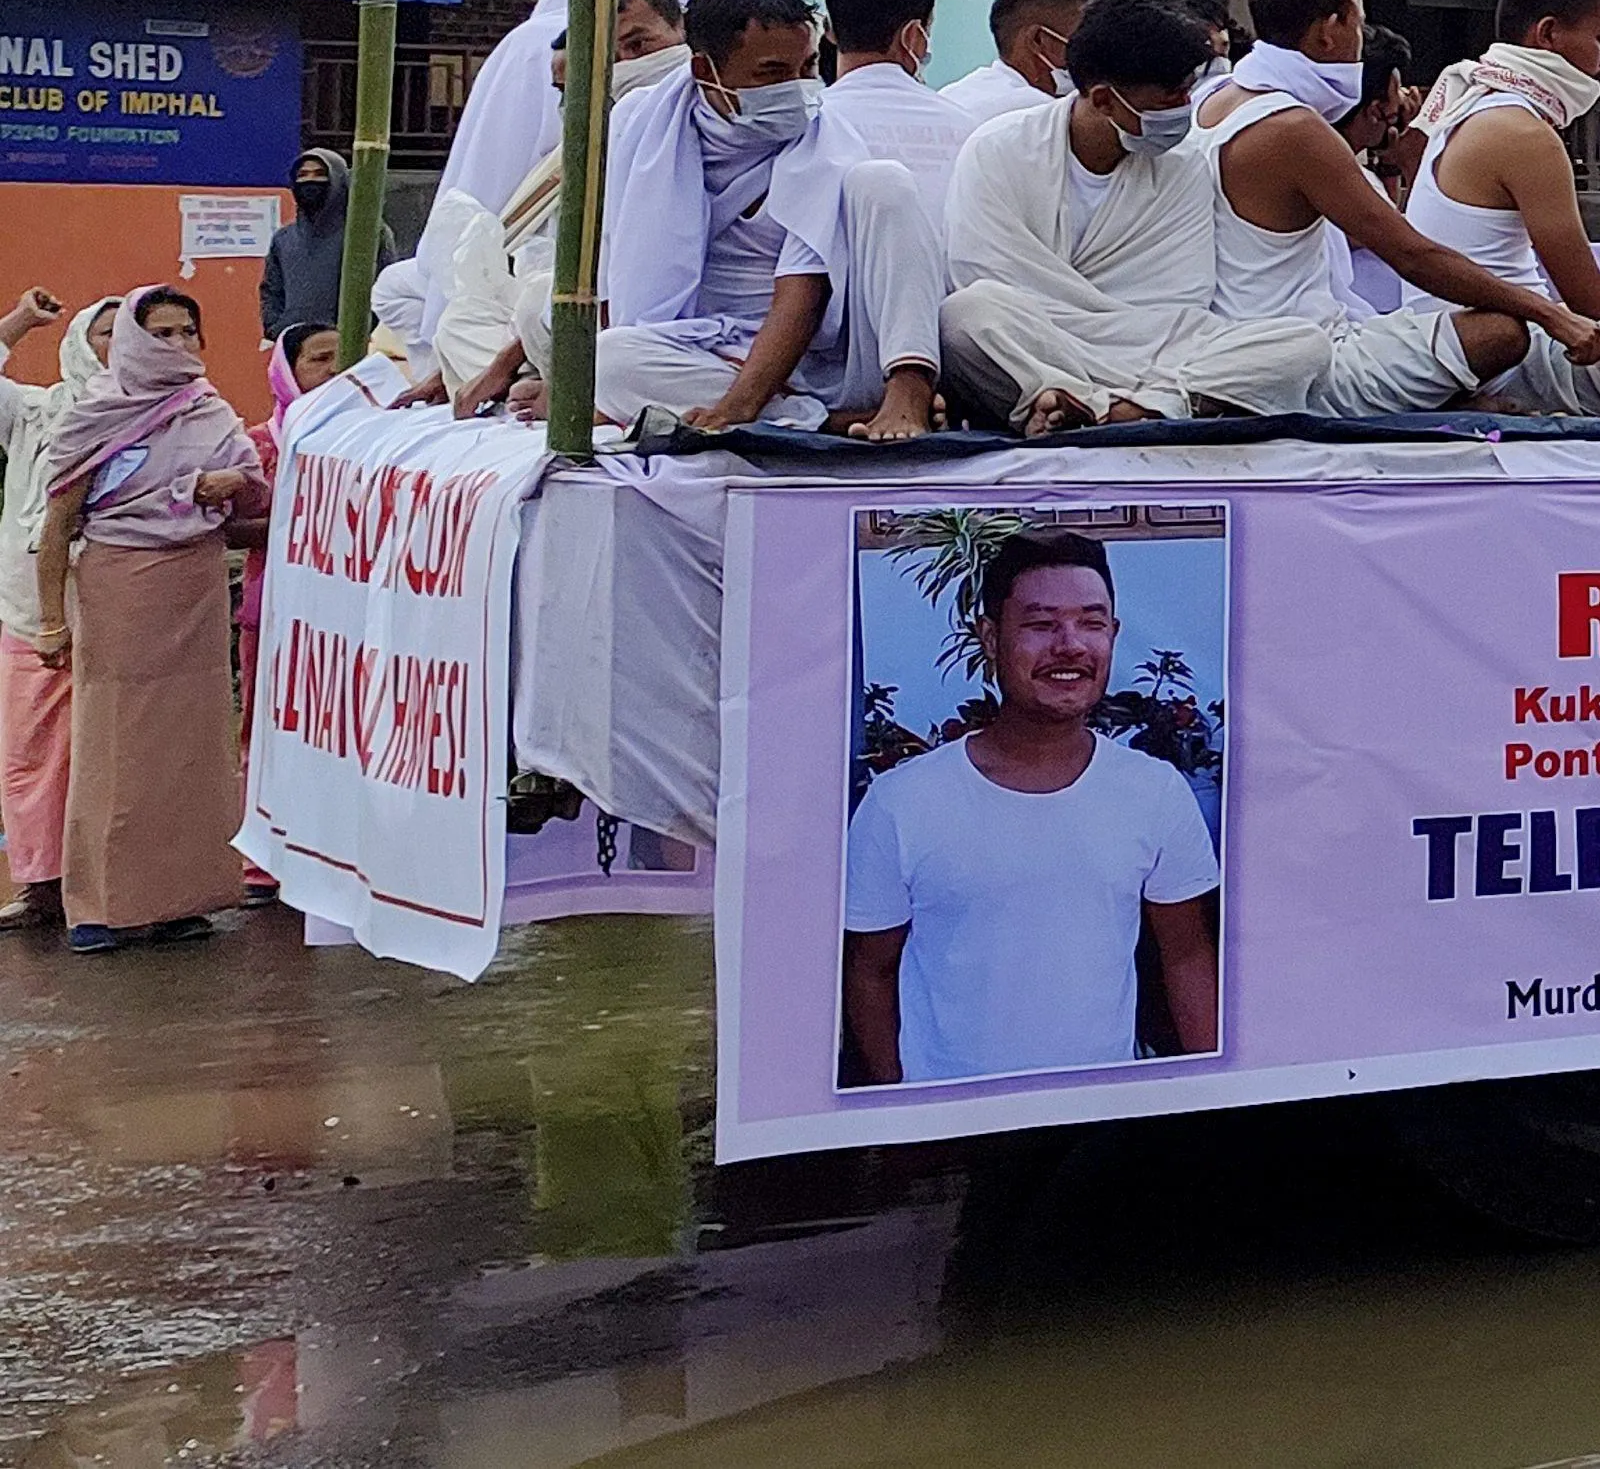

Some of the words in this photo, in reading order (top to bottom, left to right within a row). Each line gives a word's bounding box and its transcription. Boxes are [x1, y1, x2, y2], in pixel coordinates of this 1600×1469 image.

[0, 36, 74, 77] NAL
[89, 41, 184, 81] SHED
[0, 86, 64, 112] CLUB
[77, 89, 110, 113] OF
[120, 91, 225, 118] IMPHAL
